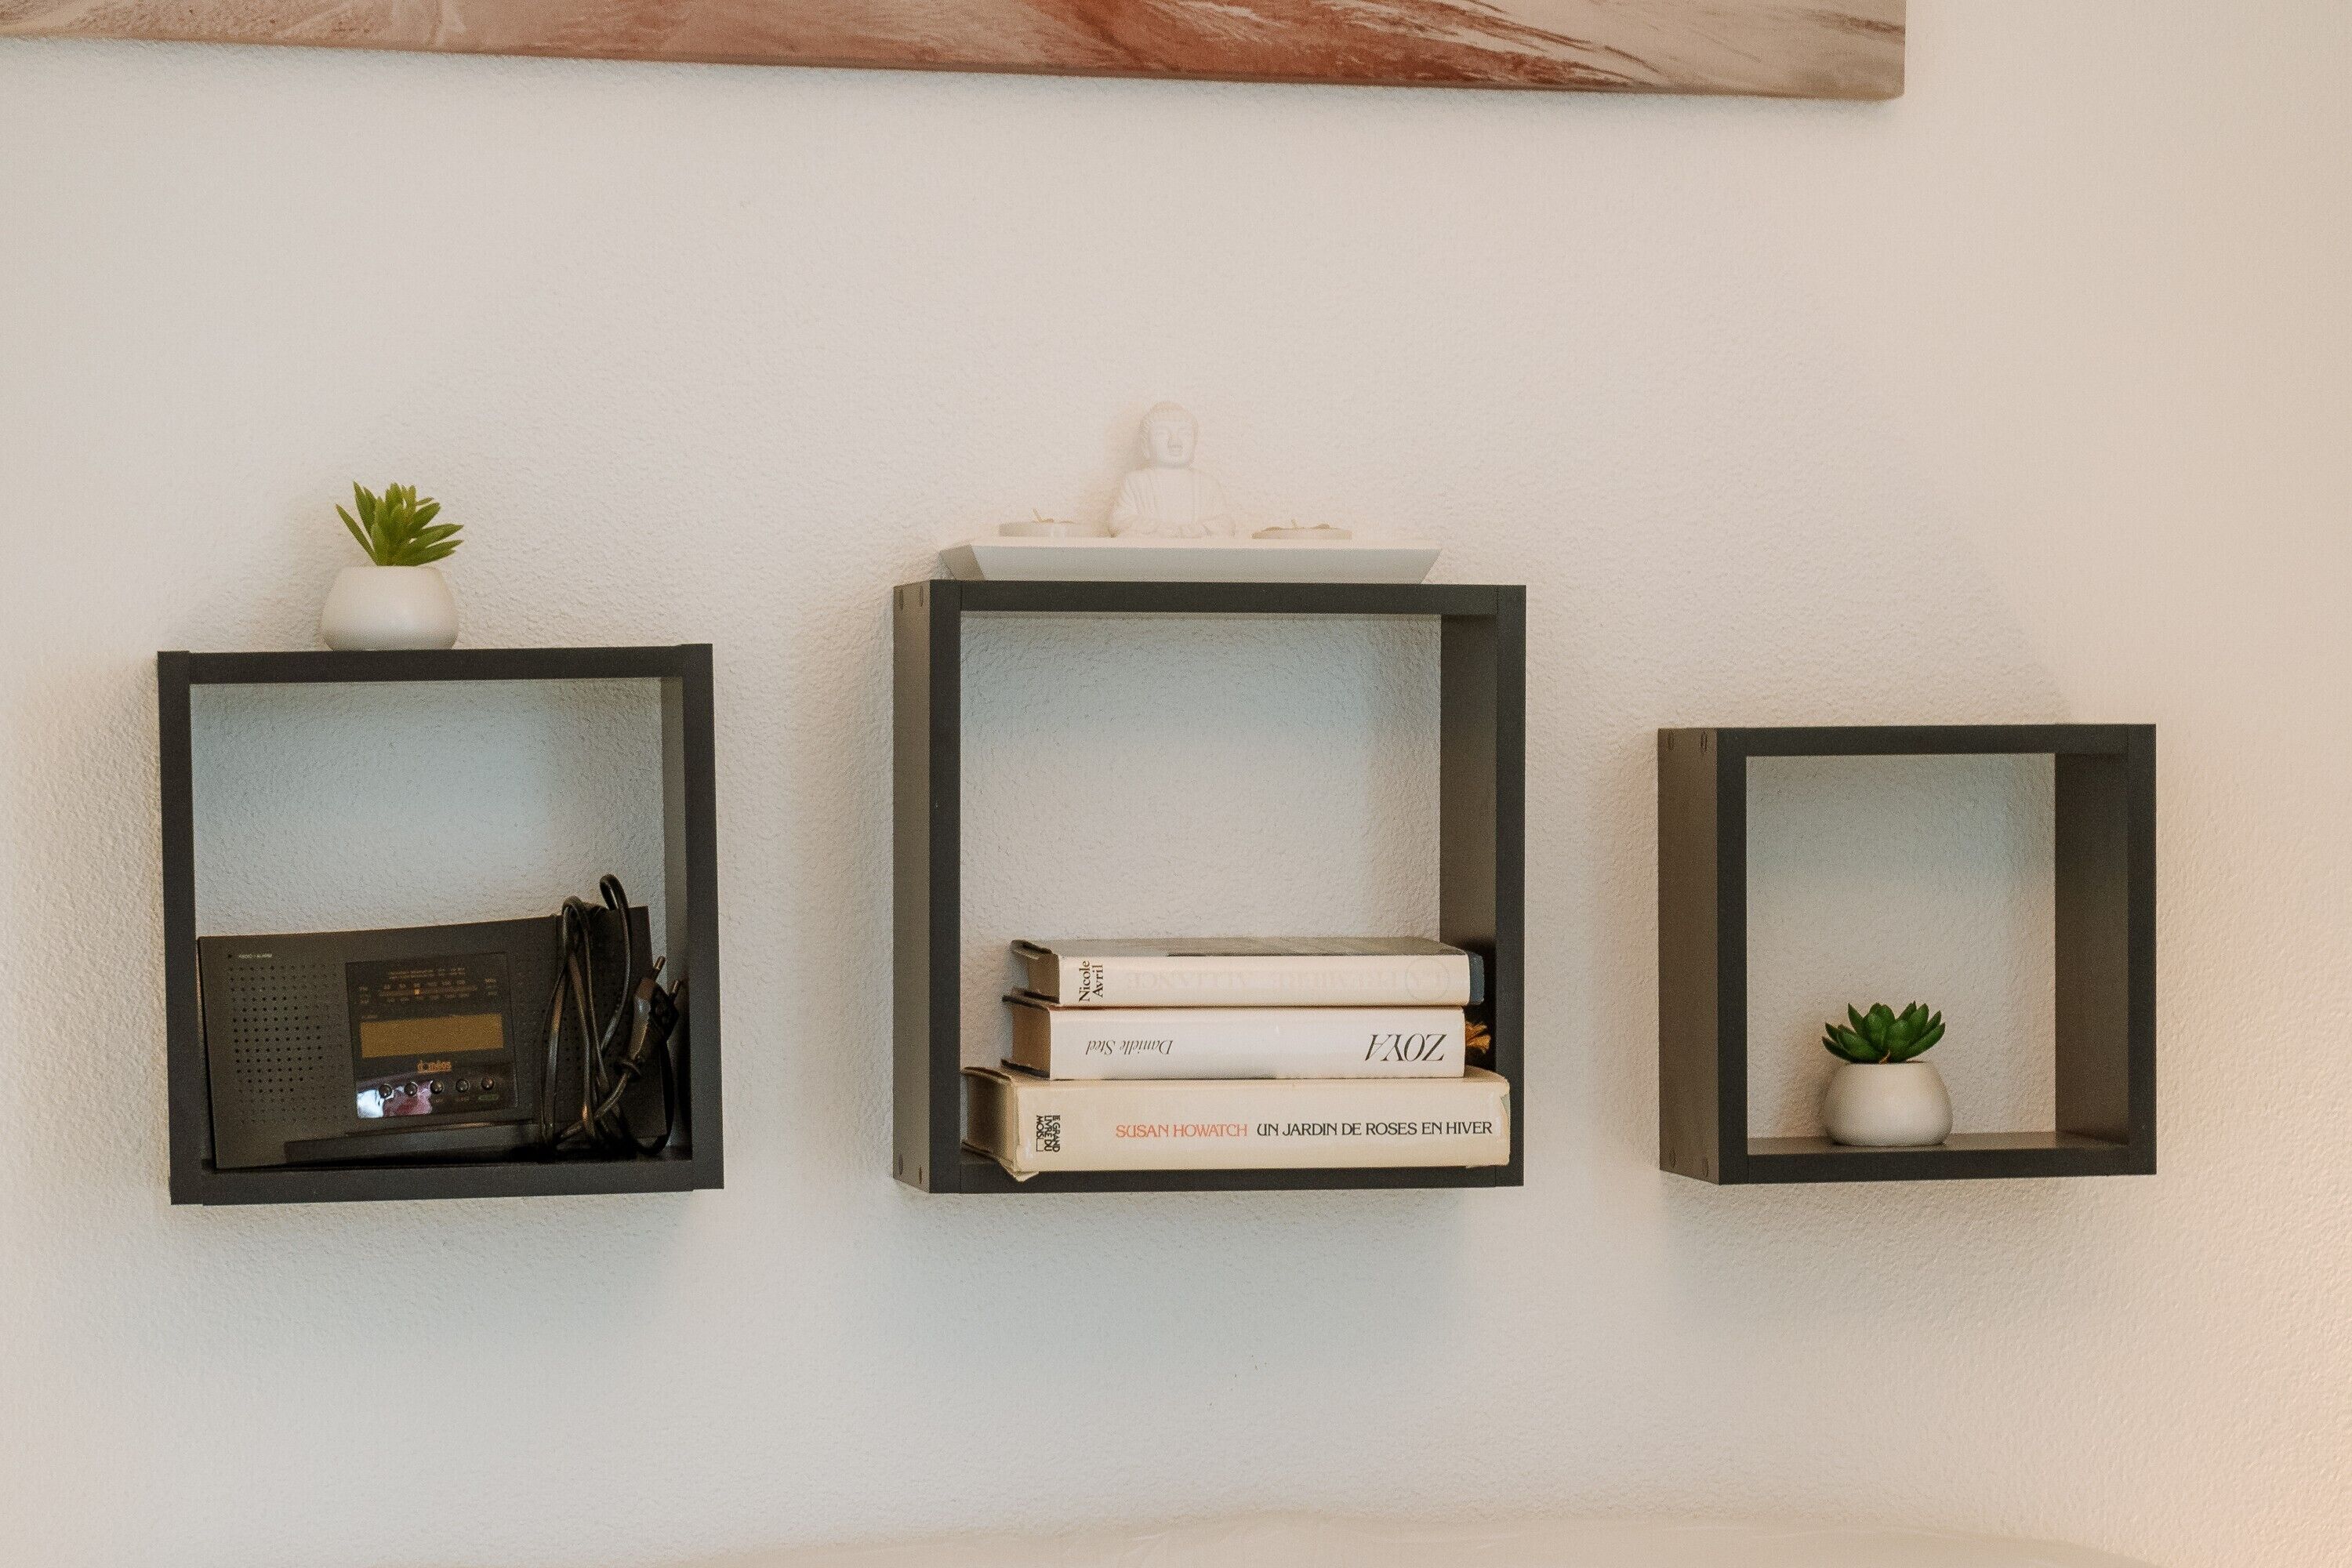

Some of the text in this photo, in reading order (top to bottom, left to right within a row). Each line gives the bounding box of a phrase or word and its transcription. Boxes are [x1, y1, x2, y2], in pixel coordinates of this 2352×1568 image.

[1078, 960, 1091, 1002] Nicole
[1092, 964, 1104, 998] Avril
[1127, 971, 1250, 989] ALLIANCE
[1086, 1040, 1174, 1055] Danielle Steel
[1365, 1034, 1447, 1062] ZOYA
[1036, 1115, 1045, 1138] MOIS
[1044, 1116, 1053, 1152] LIVRE DU
[1116, 1123, 1247, 1138] SUSAN HOWATCH
[1257, 1121, 1493, 1136] UN JARDIN DE ROSES EN HIVER
